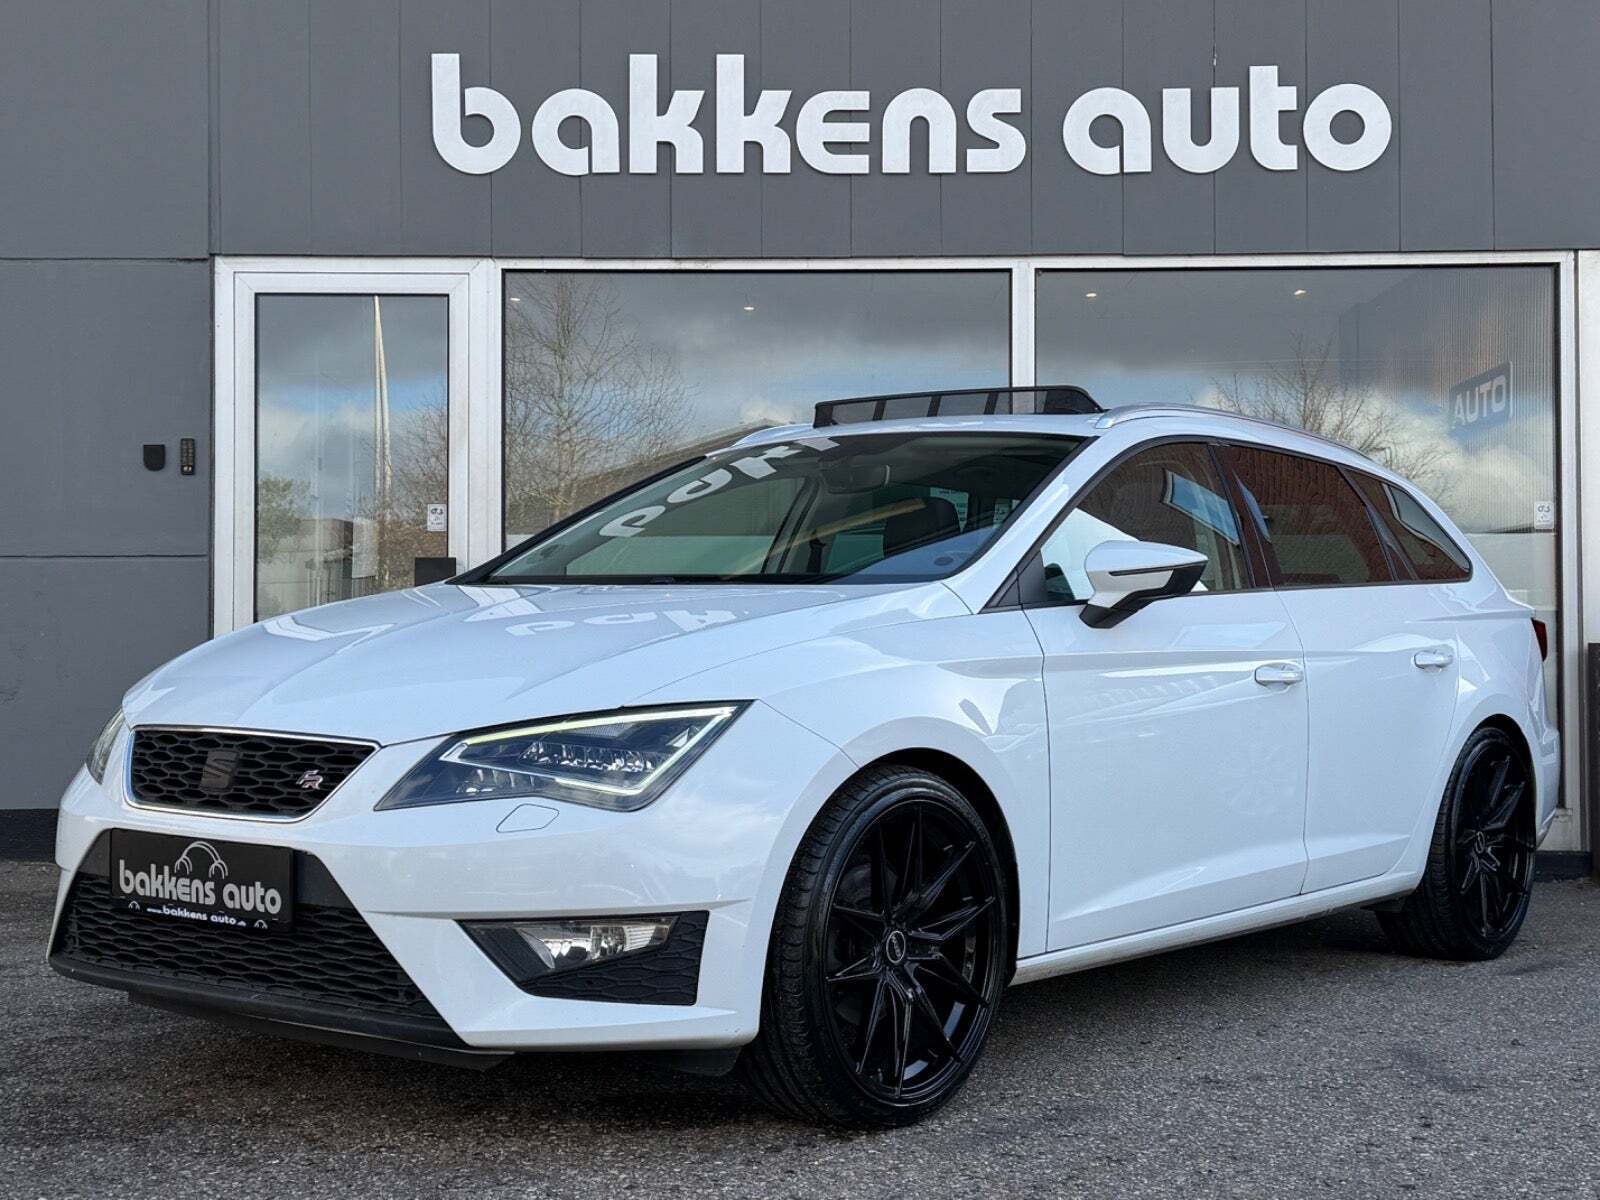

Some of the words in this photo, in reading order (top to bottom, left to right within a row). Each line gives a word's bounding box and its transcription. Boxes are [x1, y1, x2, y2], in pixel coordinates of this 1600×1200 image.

[431, 53, 1027, 176] bakkens
[1062, 65, 1393, 175] auto
[1454, 374, 1506, 426] AUTO
[119, 859, 216, 905] bakkens
[222, 881, 283, 915] auto
